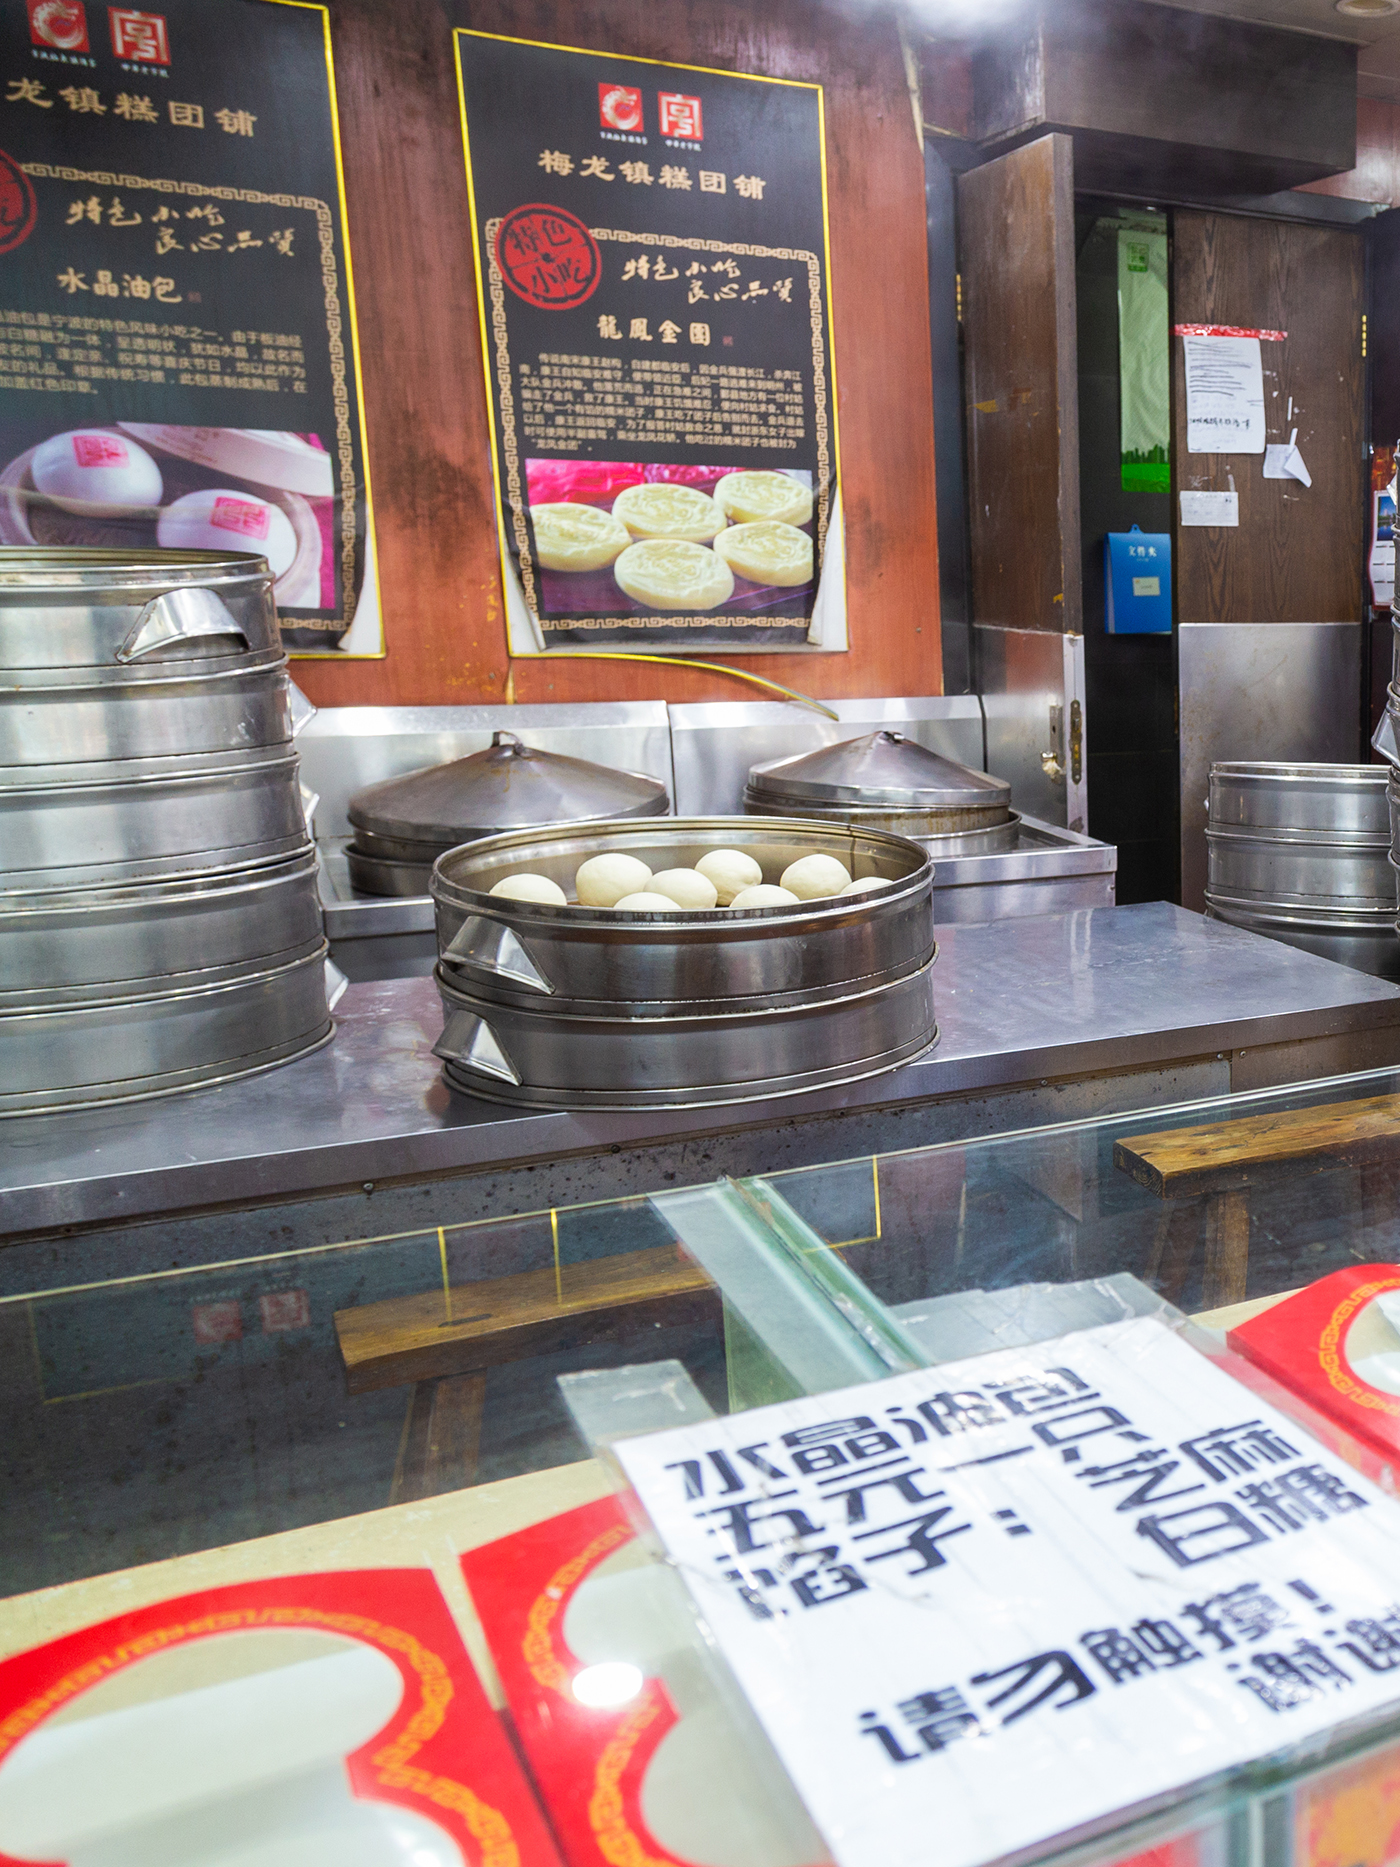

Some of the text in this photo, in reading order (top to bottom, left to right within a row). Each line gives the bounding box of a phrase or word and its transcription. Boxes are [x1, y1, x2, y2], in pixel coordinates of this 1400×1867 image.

[5, 77, 258, 138] 龙镇糕团铺
[537, 149, 767, 201] 梅龙镇糕团铺
[57, 267, 183, 304] 水晶油包
[665, 1366, 1101, 1504] 水晶油包
[1074, 1418, 1302, 1513] 芝麻
[695, 1409, 1135, 1562] 五元一只
[1134, 1464, 1370, 1569] 白糖
[860, 1578, 1334, 1765] 请勿触摸！
